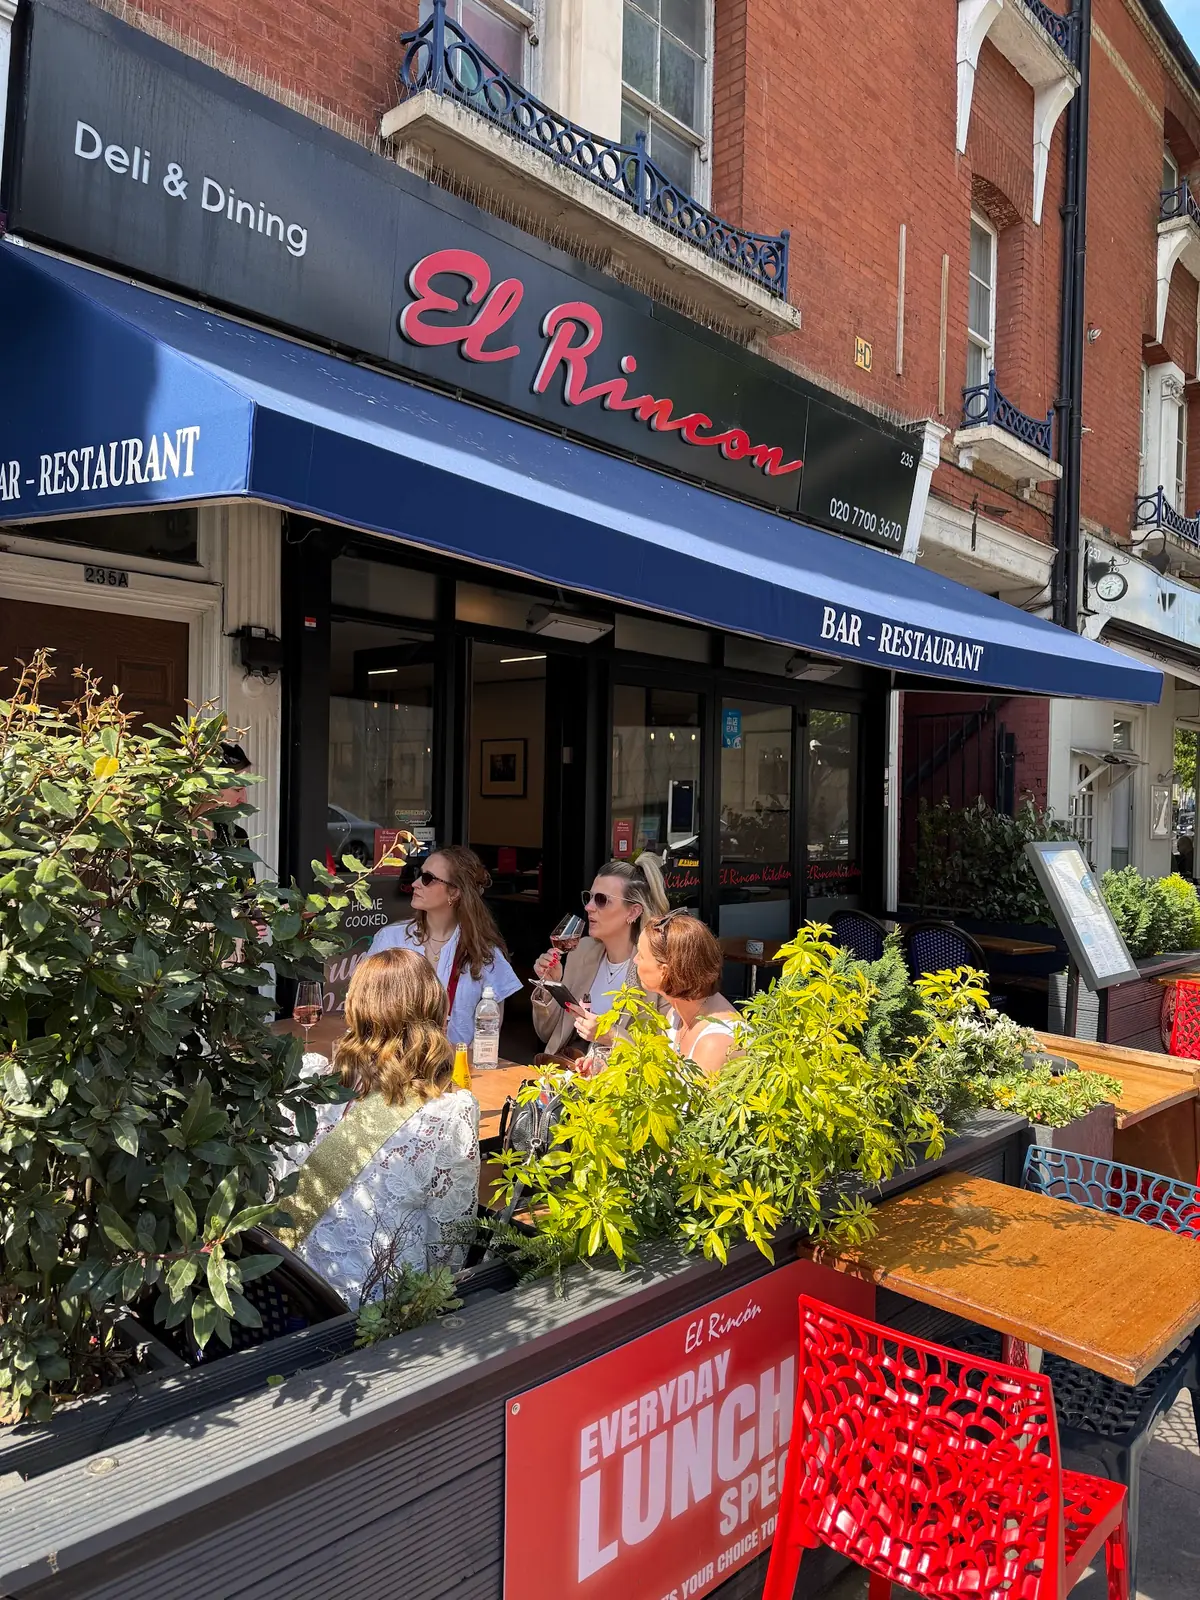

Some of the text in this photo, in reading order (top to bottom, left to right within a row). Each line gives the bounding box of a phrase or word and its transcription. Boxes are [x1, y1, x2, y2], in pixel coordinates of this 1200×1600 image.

[74, 119, 309, 257] Deli & Dining
[399, 248, 803, 477] El Rincon
[37, 425, 201, 497] RESTAURANT
[900, 451, 914, 469] 235
[829, 497, 902, 542] 020 7700 3670
[84, 567, 128, 587] 235A
[819, 605, 862, 648] BAR
[878, 622, 985, 673] RESTAURANT
[663, 869, 701, 889] Kitchen
[719, 864, 792, 885] El Rincon Kitchen
[345, 913, 389, 928] COOKED
[684, 1298, 762, 1354] El Rincón
[579, 1348, 731, 1473] EVERYDAY
[577, 1354, 795, 1584] LUNCH
[681, 1561, 714, 1600] YOUR
[717, 1528, 759, 1573] CHOICE
